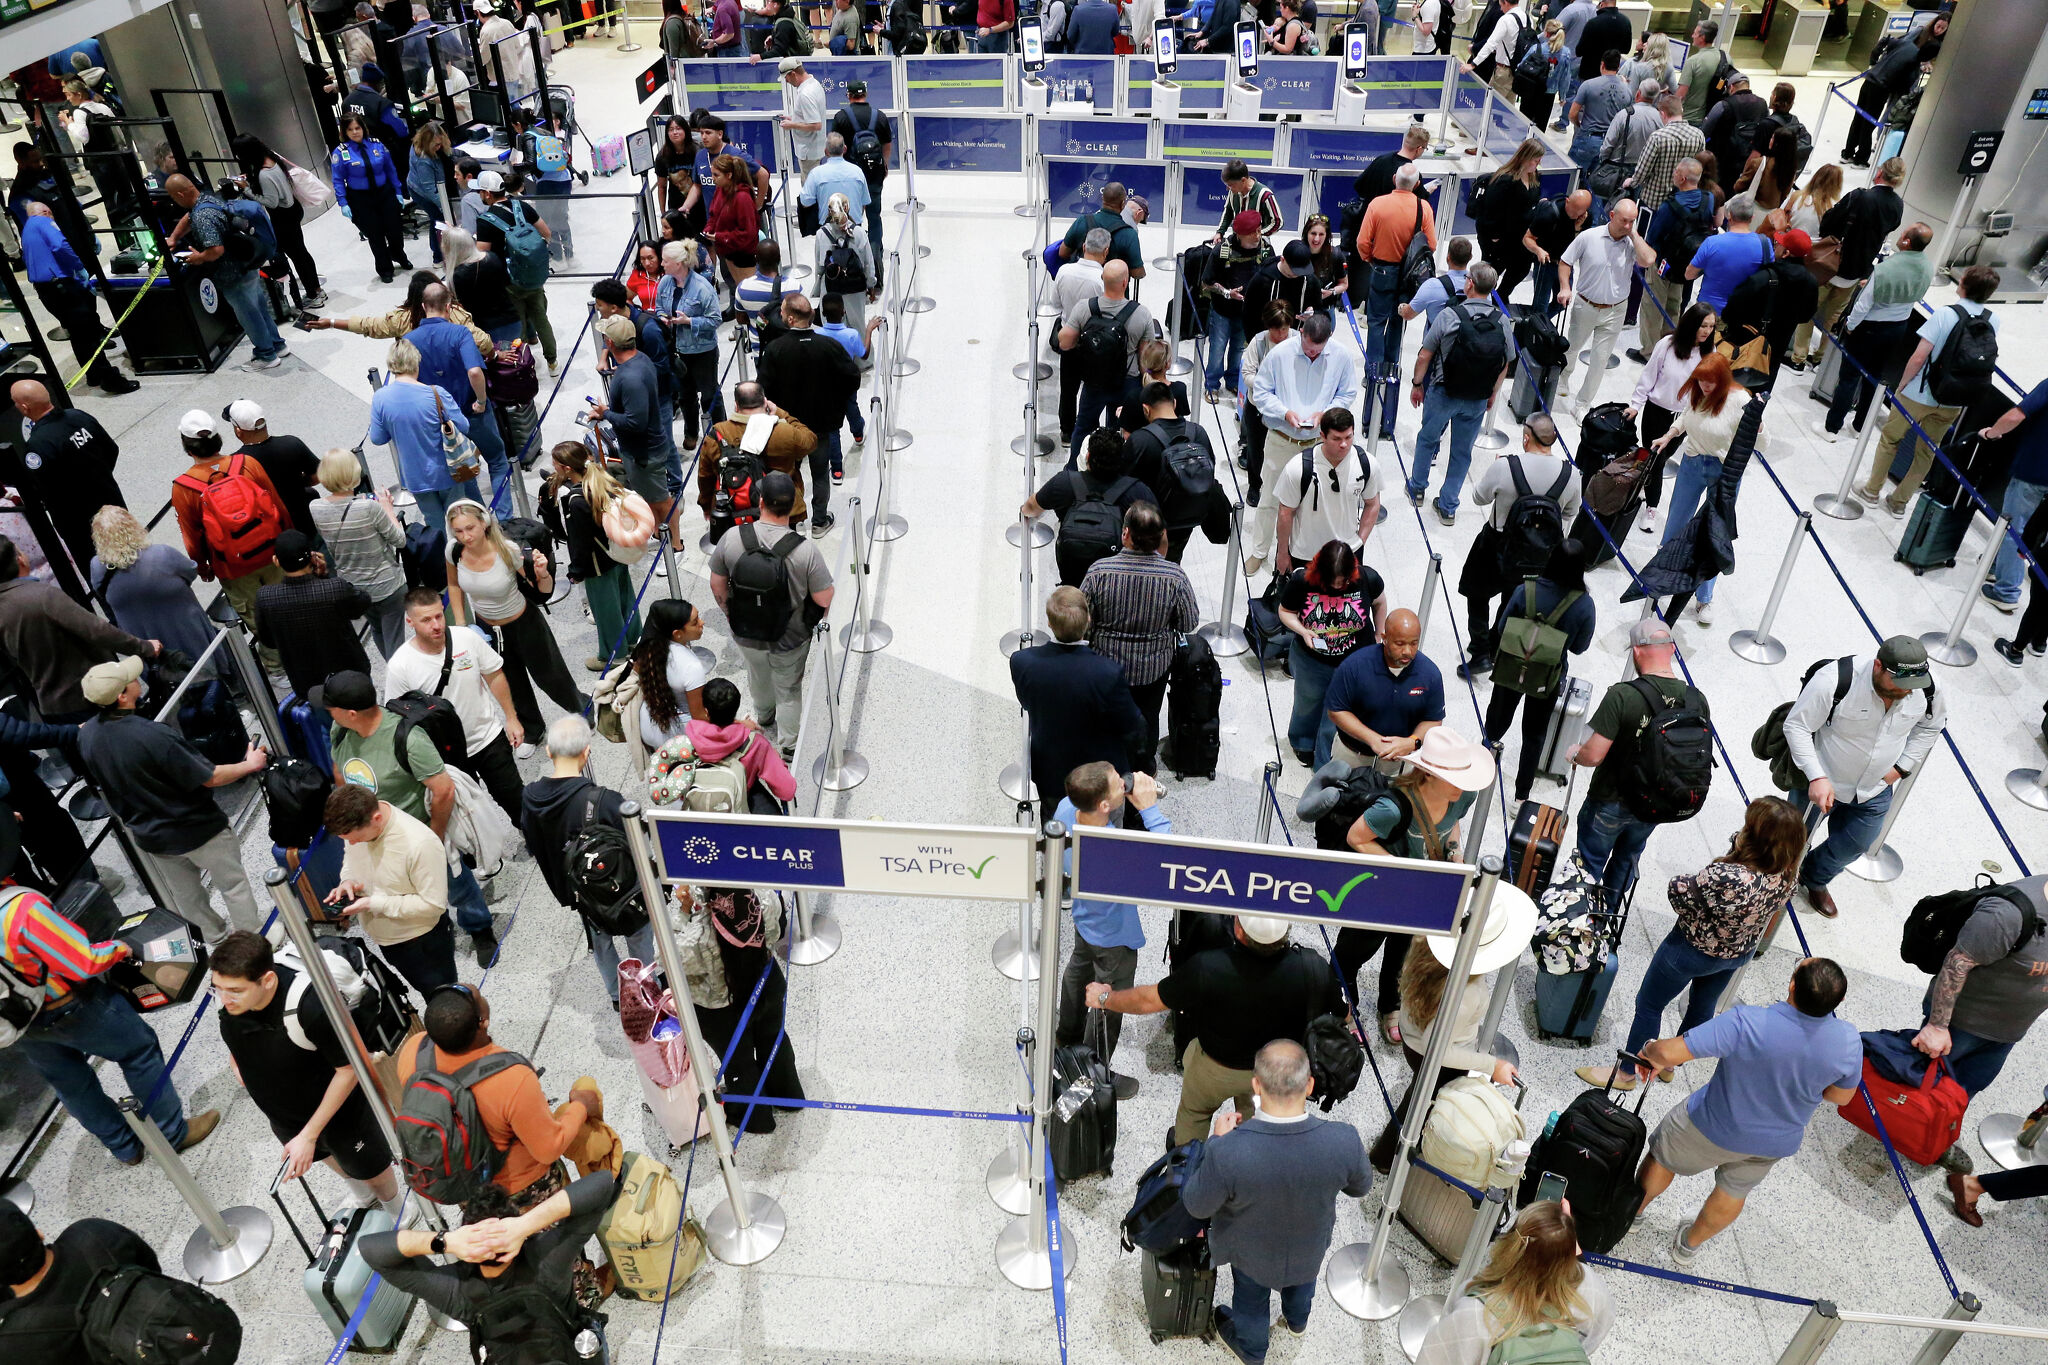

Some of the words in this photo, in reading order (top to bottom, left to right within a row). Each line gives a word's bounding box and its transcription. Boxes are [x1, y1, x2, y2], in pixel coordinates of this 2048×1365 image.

[350, 104, 365, 115] TSA
[70, 428, 93, 448] TSA
[732, 846, 813, 862] CLEAR
[918, 846, 952, 854] WITH
[880, 856, 923, 873] TSA
[929, 859, 965, 875] Pre
[1160, 862, 1235, 896] TSA
[1246, 872, 1313, 904] Pre
[754, 977, 765, 995] CLEAR
[1862, 1089, 1874, 1109] UNITED
[1897, 1169, 1909, 1191] UNITED
[619, 1255, 643, 1285] RTIC
[1590, 1256, 1616, 1265] UNITED
[1937, 1258, 1950, 1282] UNITED
[1697, 1279, 1725, 1288] UNITED
[330, 1336, 348, 1363] UNITED
